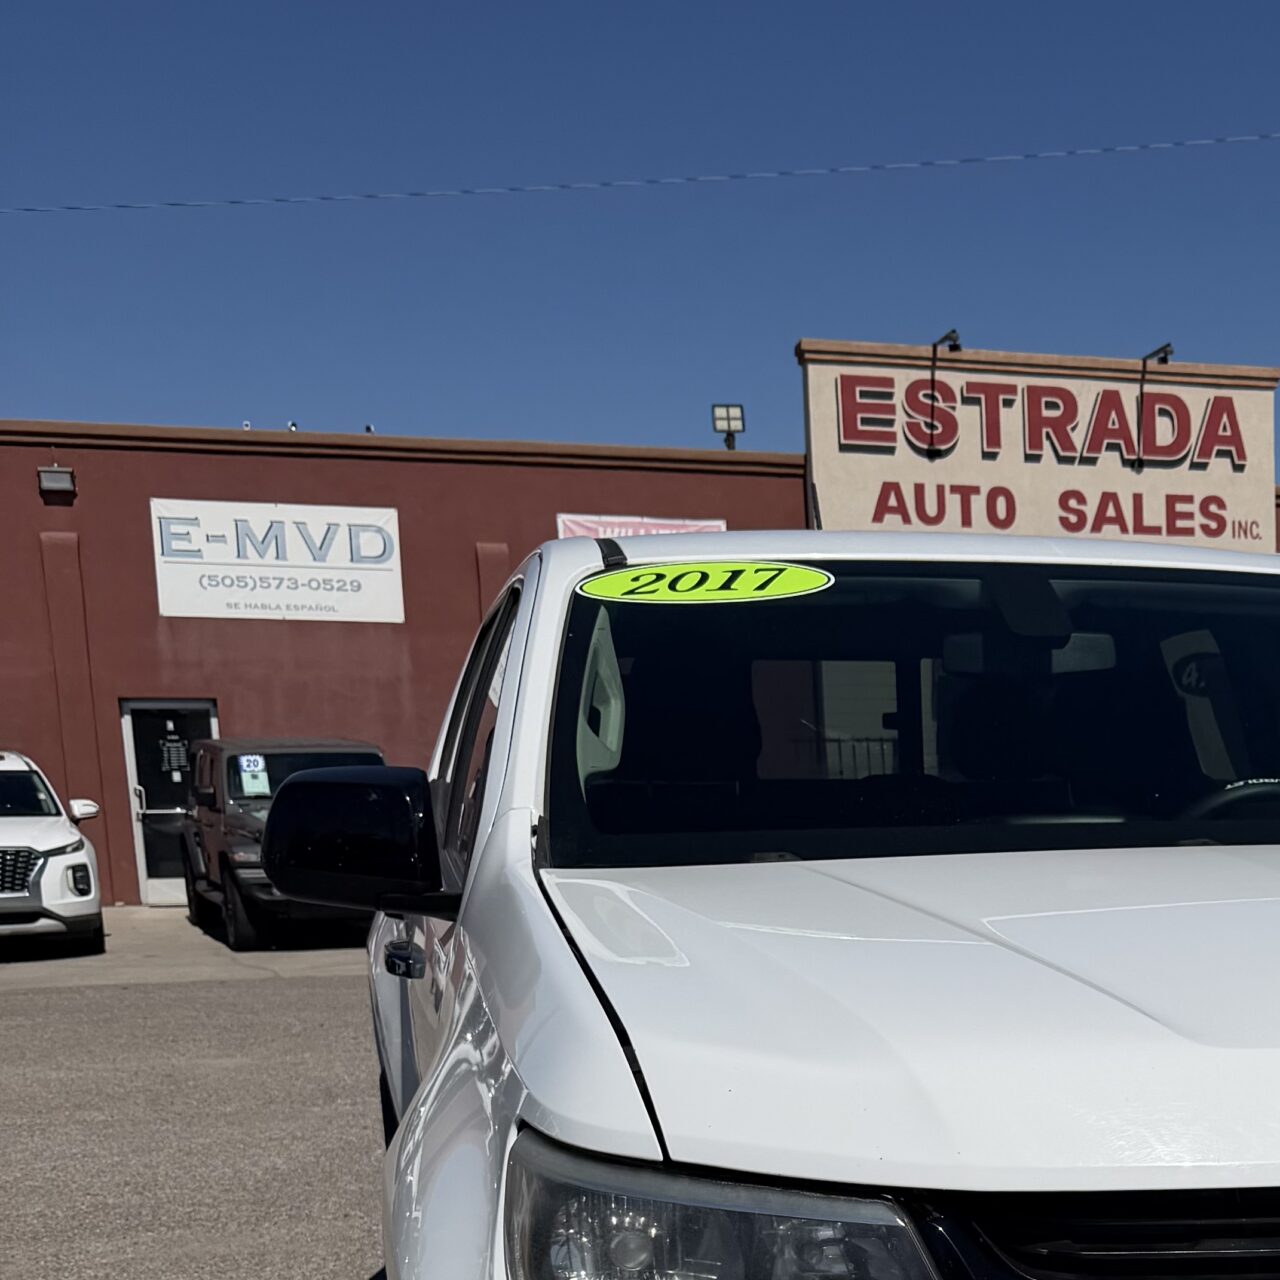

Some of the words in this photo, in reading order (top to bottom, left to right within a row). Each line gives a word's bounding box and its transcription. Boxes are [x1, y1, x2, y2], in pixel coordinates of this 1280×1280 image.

[837, 374, 1248, 472] ESTRADA
[871, 481, 1017, 530] AUTO
[1058, 489, 1228, 538] SALES
[1231, 520, 1262, 540] INC.
[157, 516, 395, 565] E-MVD
[199, 573, 362, 593] (505)573-0529
[621, 568, 789, 596] 2017
[226, 602, 241, 610] SE
[243, 602, 282, 611] HABLA
[285, 603, 339, 613] ESPAÑOL
[246, 759, 259, 768] 20
